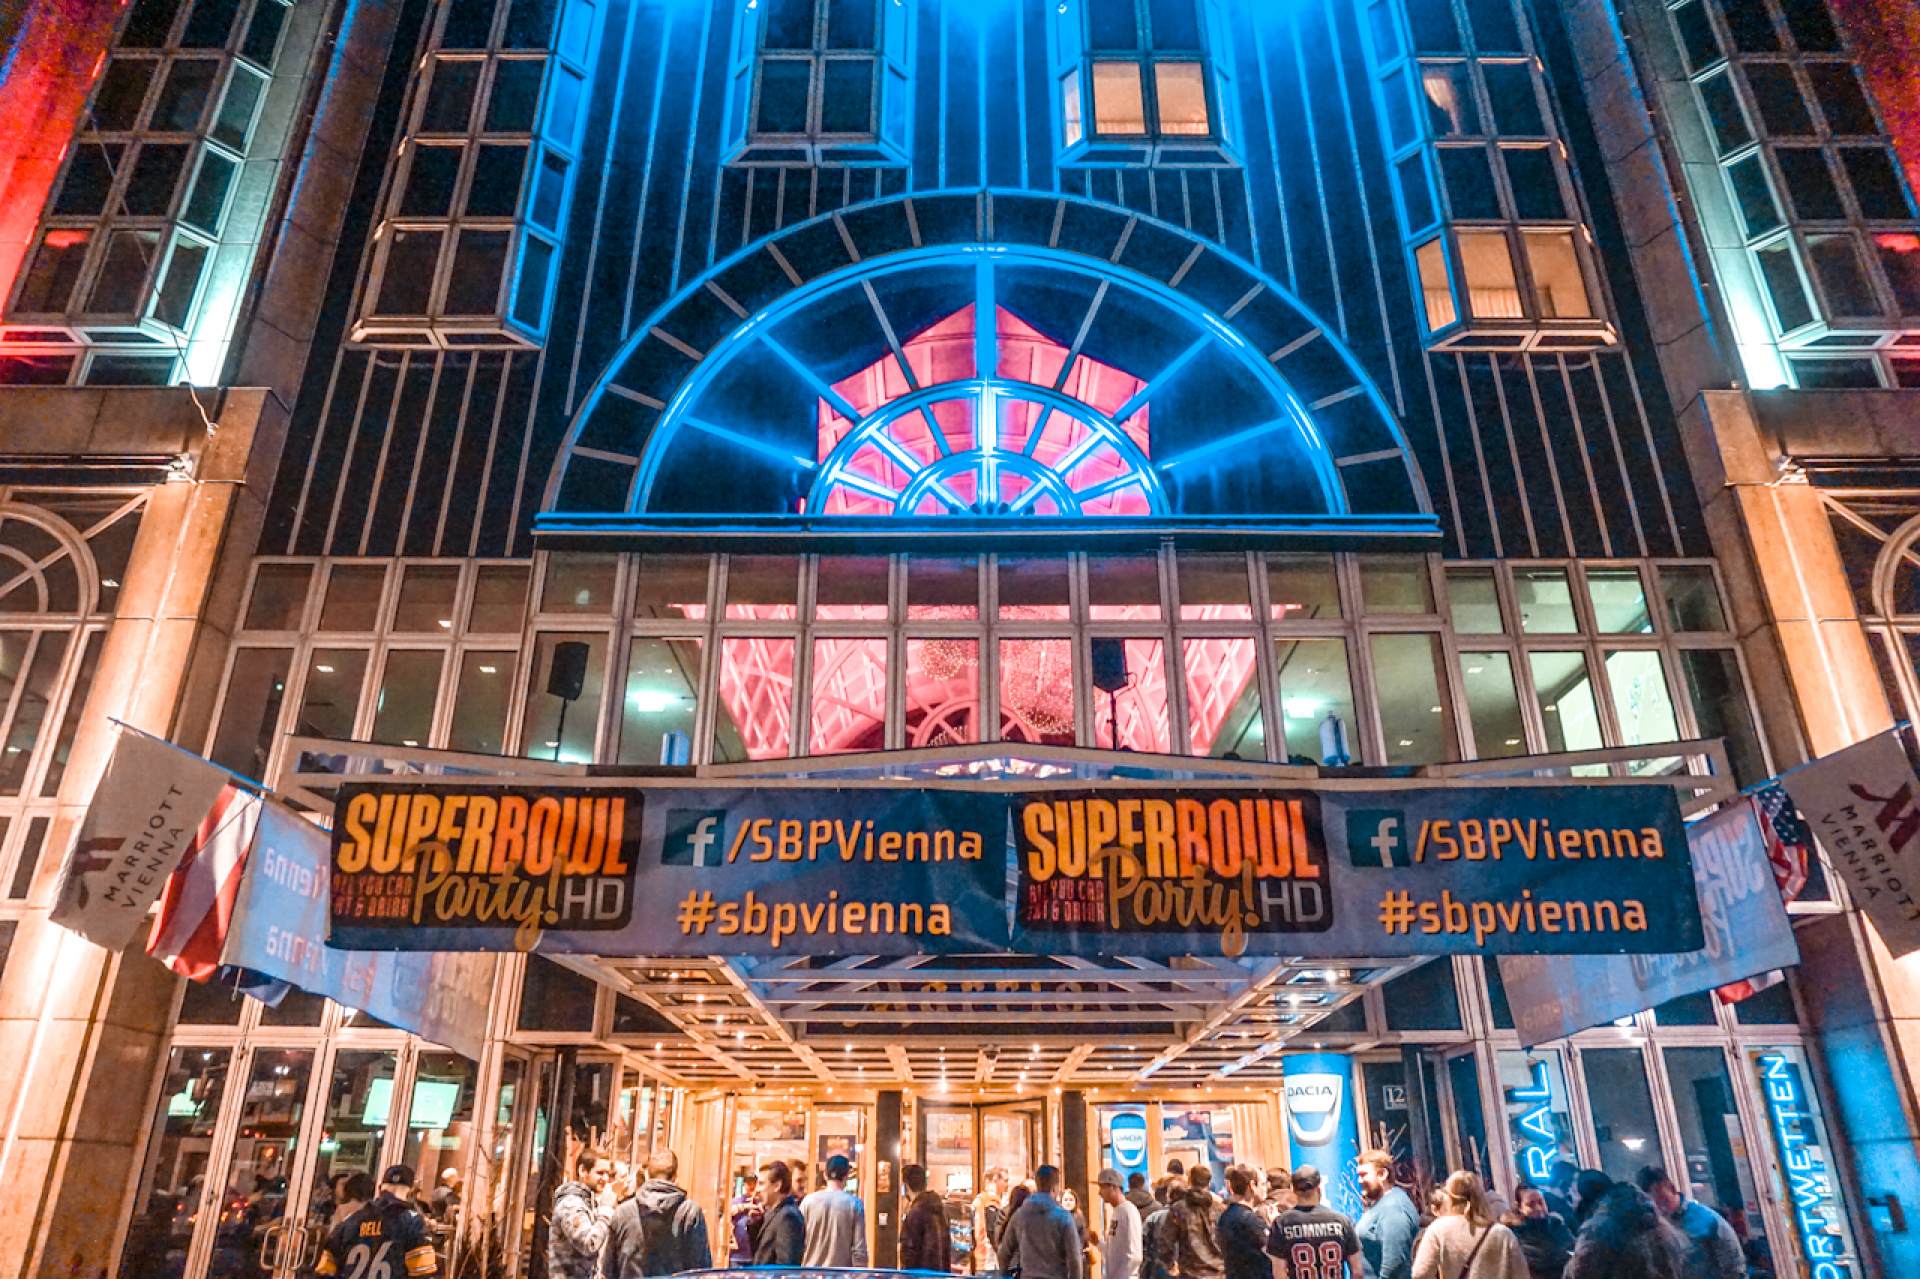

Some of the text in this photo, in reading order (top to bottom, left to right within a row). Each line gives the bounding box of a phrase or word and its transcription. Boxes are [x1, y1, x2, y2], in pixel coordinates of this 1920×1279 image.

[103, 783, 183, 902] MARRIOTT
[337, 793, 628, 876] SUPERBOWL
[1022, 798, 1321, 882] SUPERBOWL
[1822, 812, 1881, 899] VIENNA
[121, 827, 185, 908] VIENNA
[561, 878, 625, 920] HD
[676, 888, 953, 949] #sbpvienna
[1260, 878, 1325, 922] HD
[1377, 888, 1649, 947] #sbpvienna
[1287, 1085, 1334, 1098] DACIA
[1386, 1086, 1406, 1103] 12
[359, 1221, 383, 1237] BELL
[1283, 1222, 1344, 1239] SOMMER
[346, 1241, 392, 1279] 26
[1291, 1241, 1342, 1279] 88
